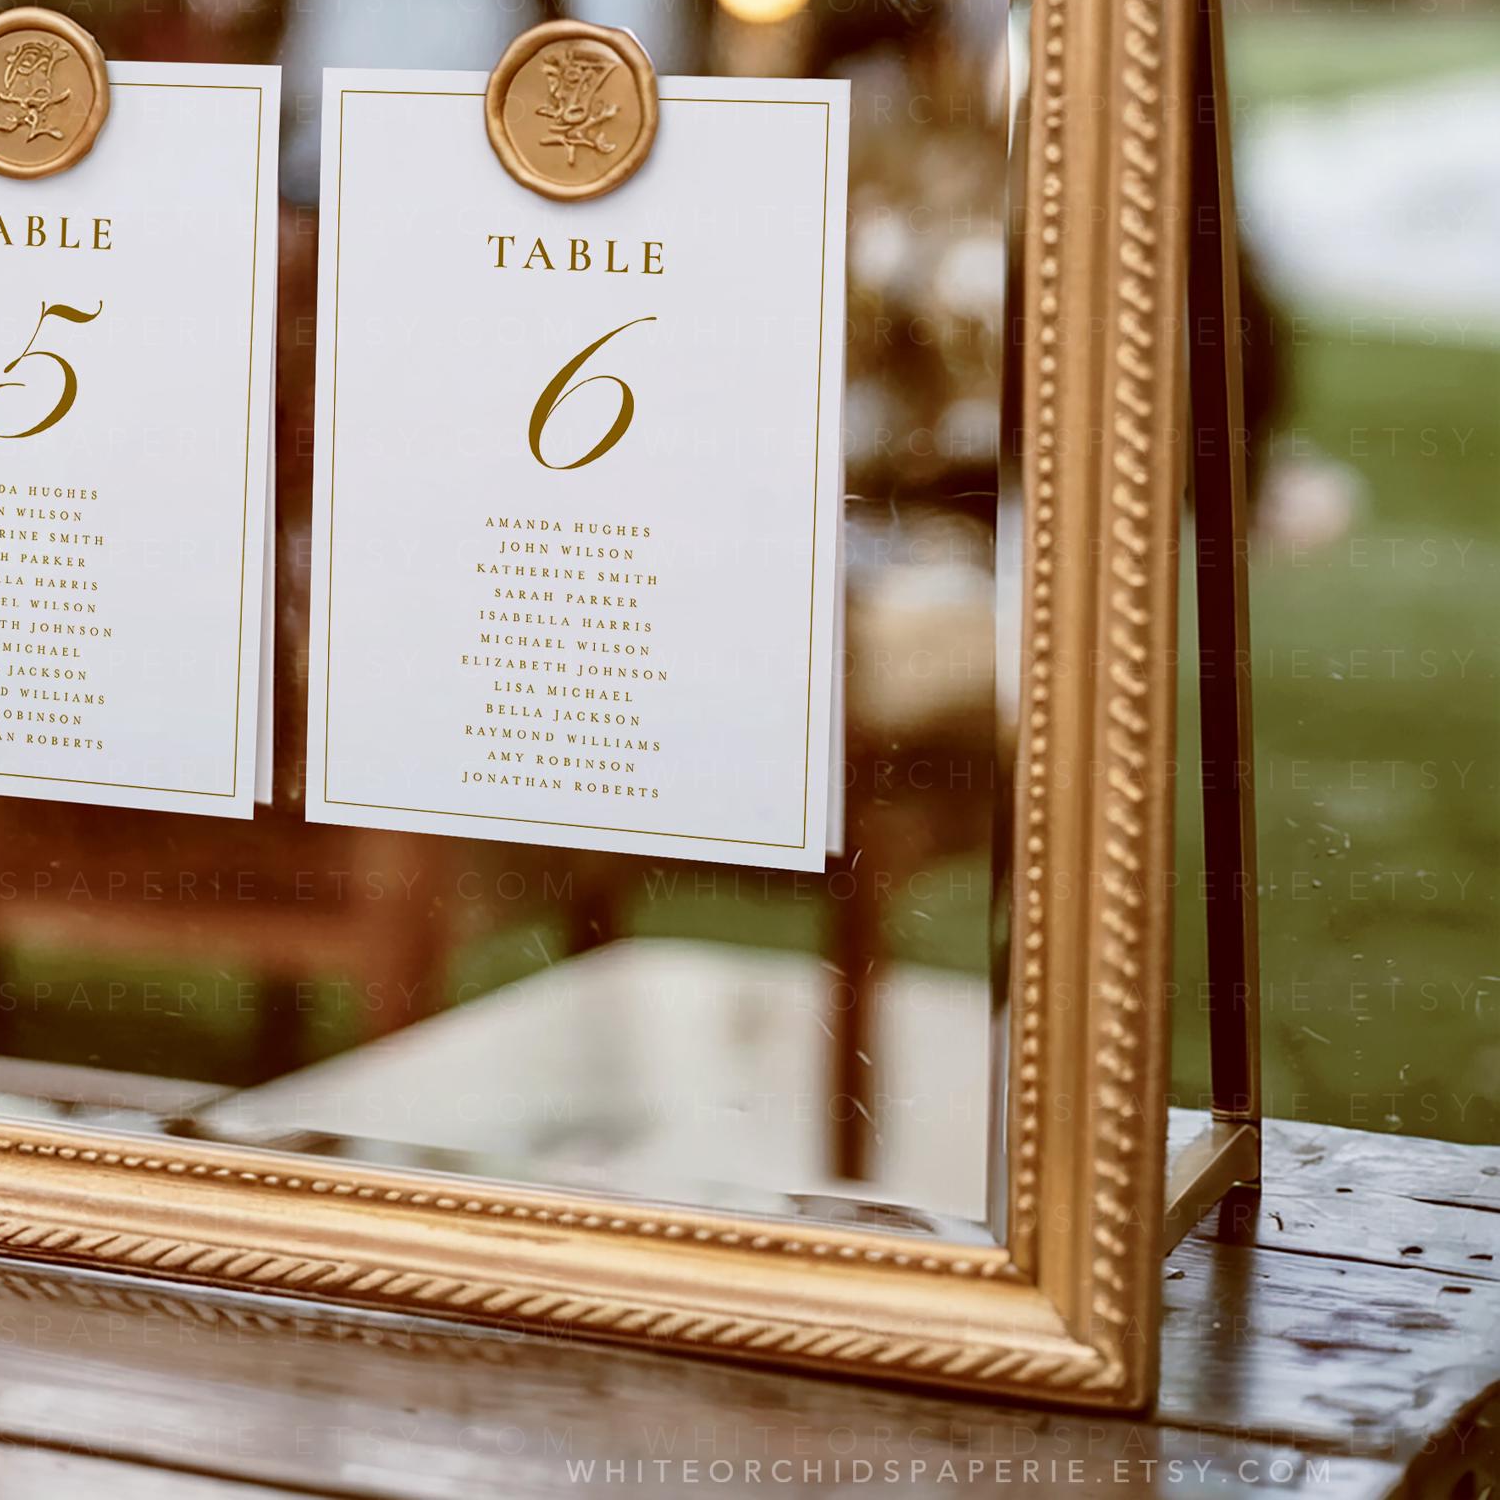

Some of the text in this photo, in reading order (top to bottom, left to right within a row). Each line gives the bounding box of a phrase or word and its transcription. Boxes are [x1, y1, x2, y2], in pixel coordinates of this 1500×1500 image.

[488, 235, 664, 274] TABLE
[528, 316, 657, 470] 6
[28, 486, 98, 501] HUGHES
[16, 507, 82, 522] WILSON
[485, 516, 650, 539] AMANDA HUGHES
[49, 532, 103, 546] SMITH
[20, 553, 85, 568] PARKER
[499, 541, 633, 560] JOHN WILSON
[35, 577, 98, 591] HARRIS
[476, 563, 657, 586] KATHERINE SMITH
[30, 599, 96, 613] WILSON
[494, 588, 637, 608] SARAH PARKER
[29, 622, 112, 638] JOHNSON
[480, 610, 652, 633] ISABELLA HARRIS
[2, 642, 80, 658] MICHAEL
[480, 633, 649, 656] MICHAEL WILSON
[7, 664, 86, 681] JACKSON
[461, 655, 667, 681] ELIZABETH JOHNSON
[19, 688, 105, 705] WILLIAMS
[494, 681, 633, 702] LISA MICHAEL
[486, 703, 640, 726] BELLA JACKSON
[26, 733, 103, 750] ROBERTS
[465, 724, 660, 752] RAYMOND WILLIAMS
[487, 750, 635, 773] AMY ROBINSON
[461, 771, 659, 799] JONATHAN ROBERTS
